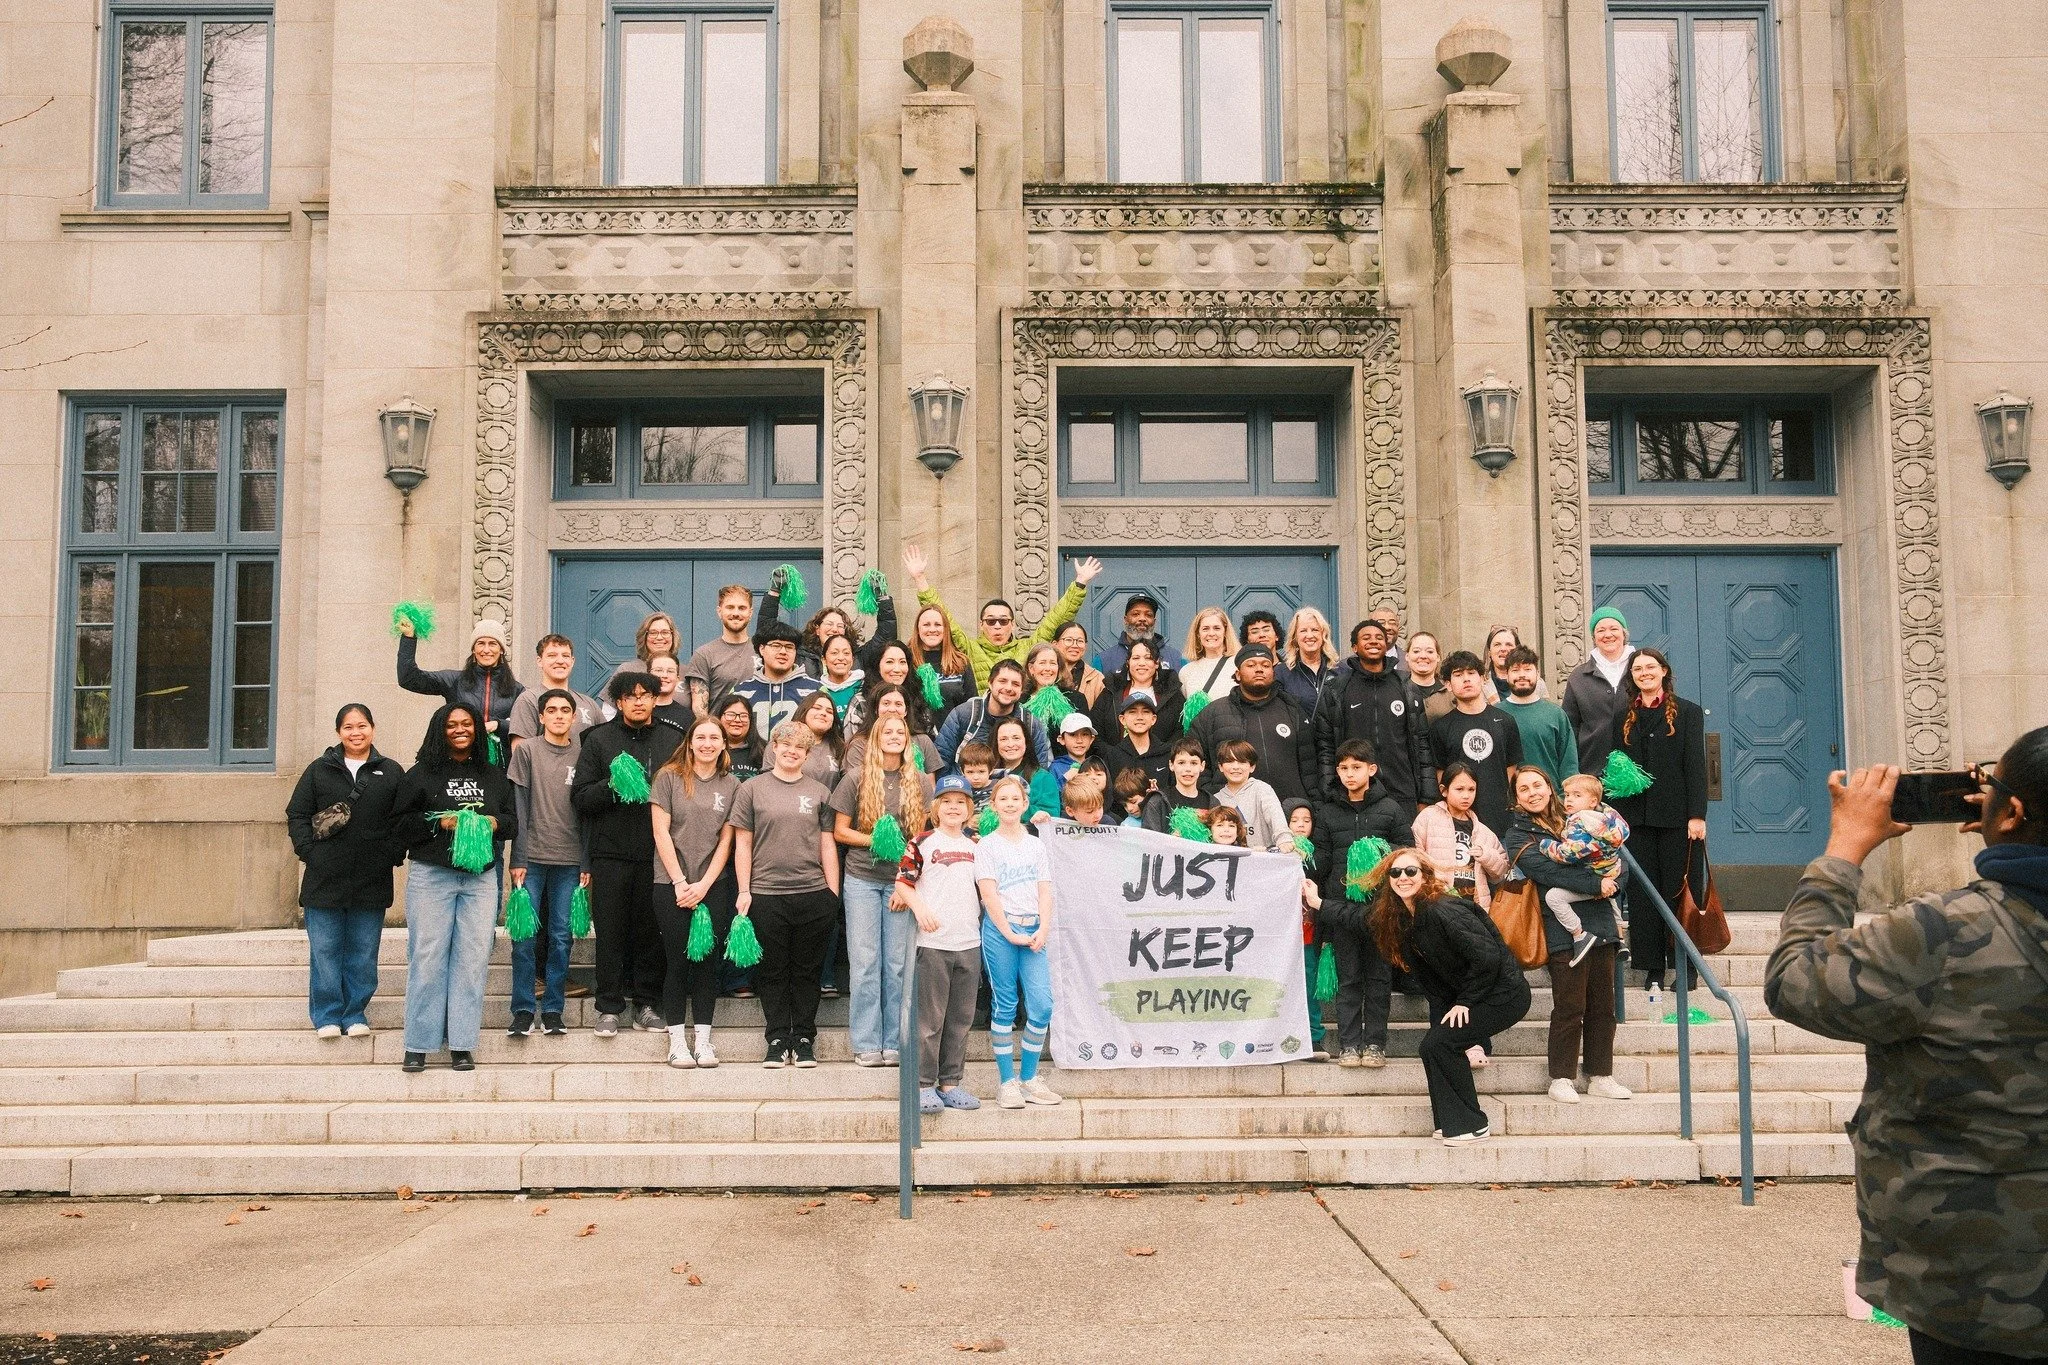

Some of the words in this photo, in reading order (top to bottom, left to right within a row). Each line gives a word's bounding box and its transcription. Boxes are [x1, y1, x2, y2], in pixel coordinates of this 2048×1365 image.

[752, 700, 799, 741] 12
[446, 788, 485, 797] EQUITY
[447, 781, 478, 790] PLAY
[1055, 826, 1082, 835] PLAY
[1084, 826, 1119, 835] EQUITY
[1122, 852, 1251, 902] JUST
[1128, 924, 1255, 973] KEEP
[1136, 988, 1252, 1015] PLAYING
